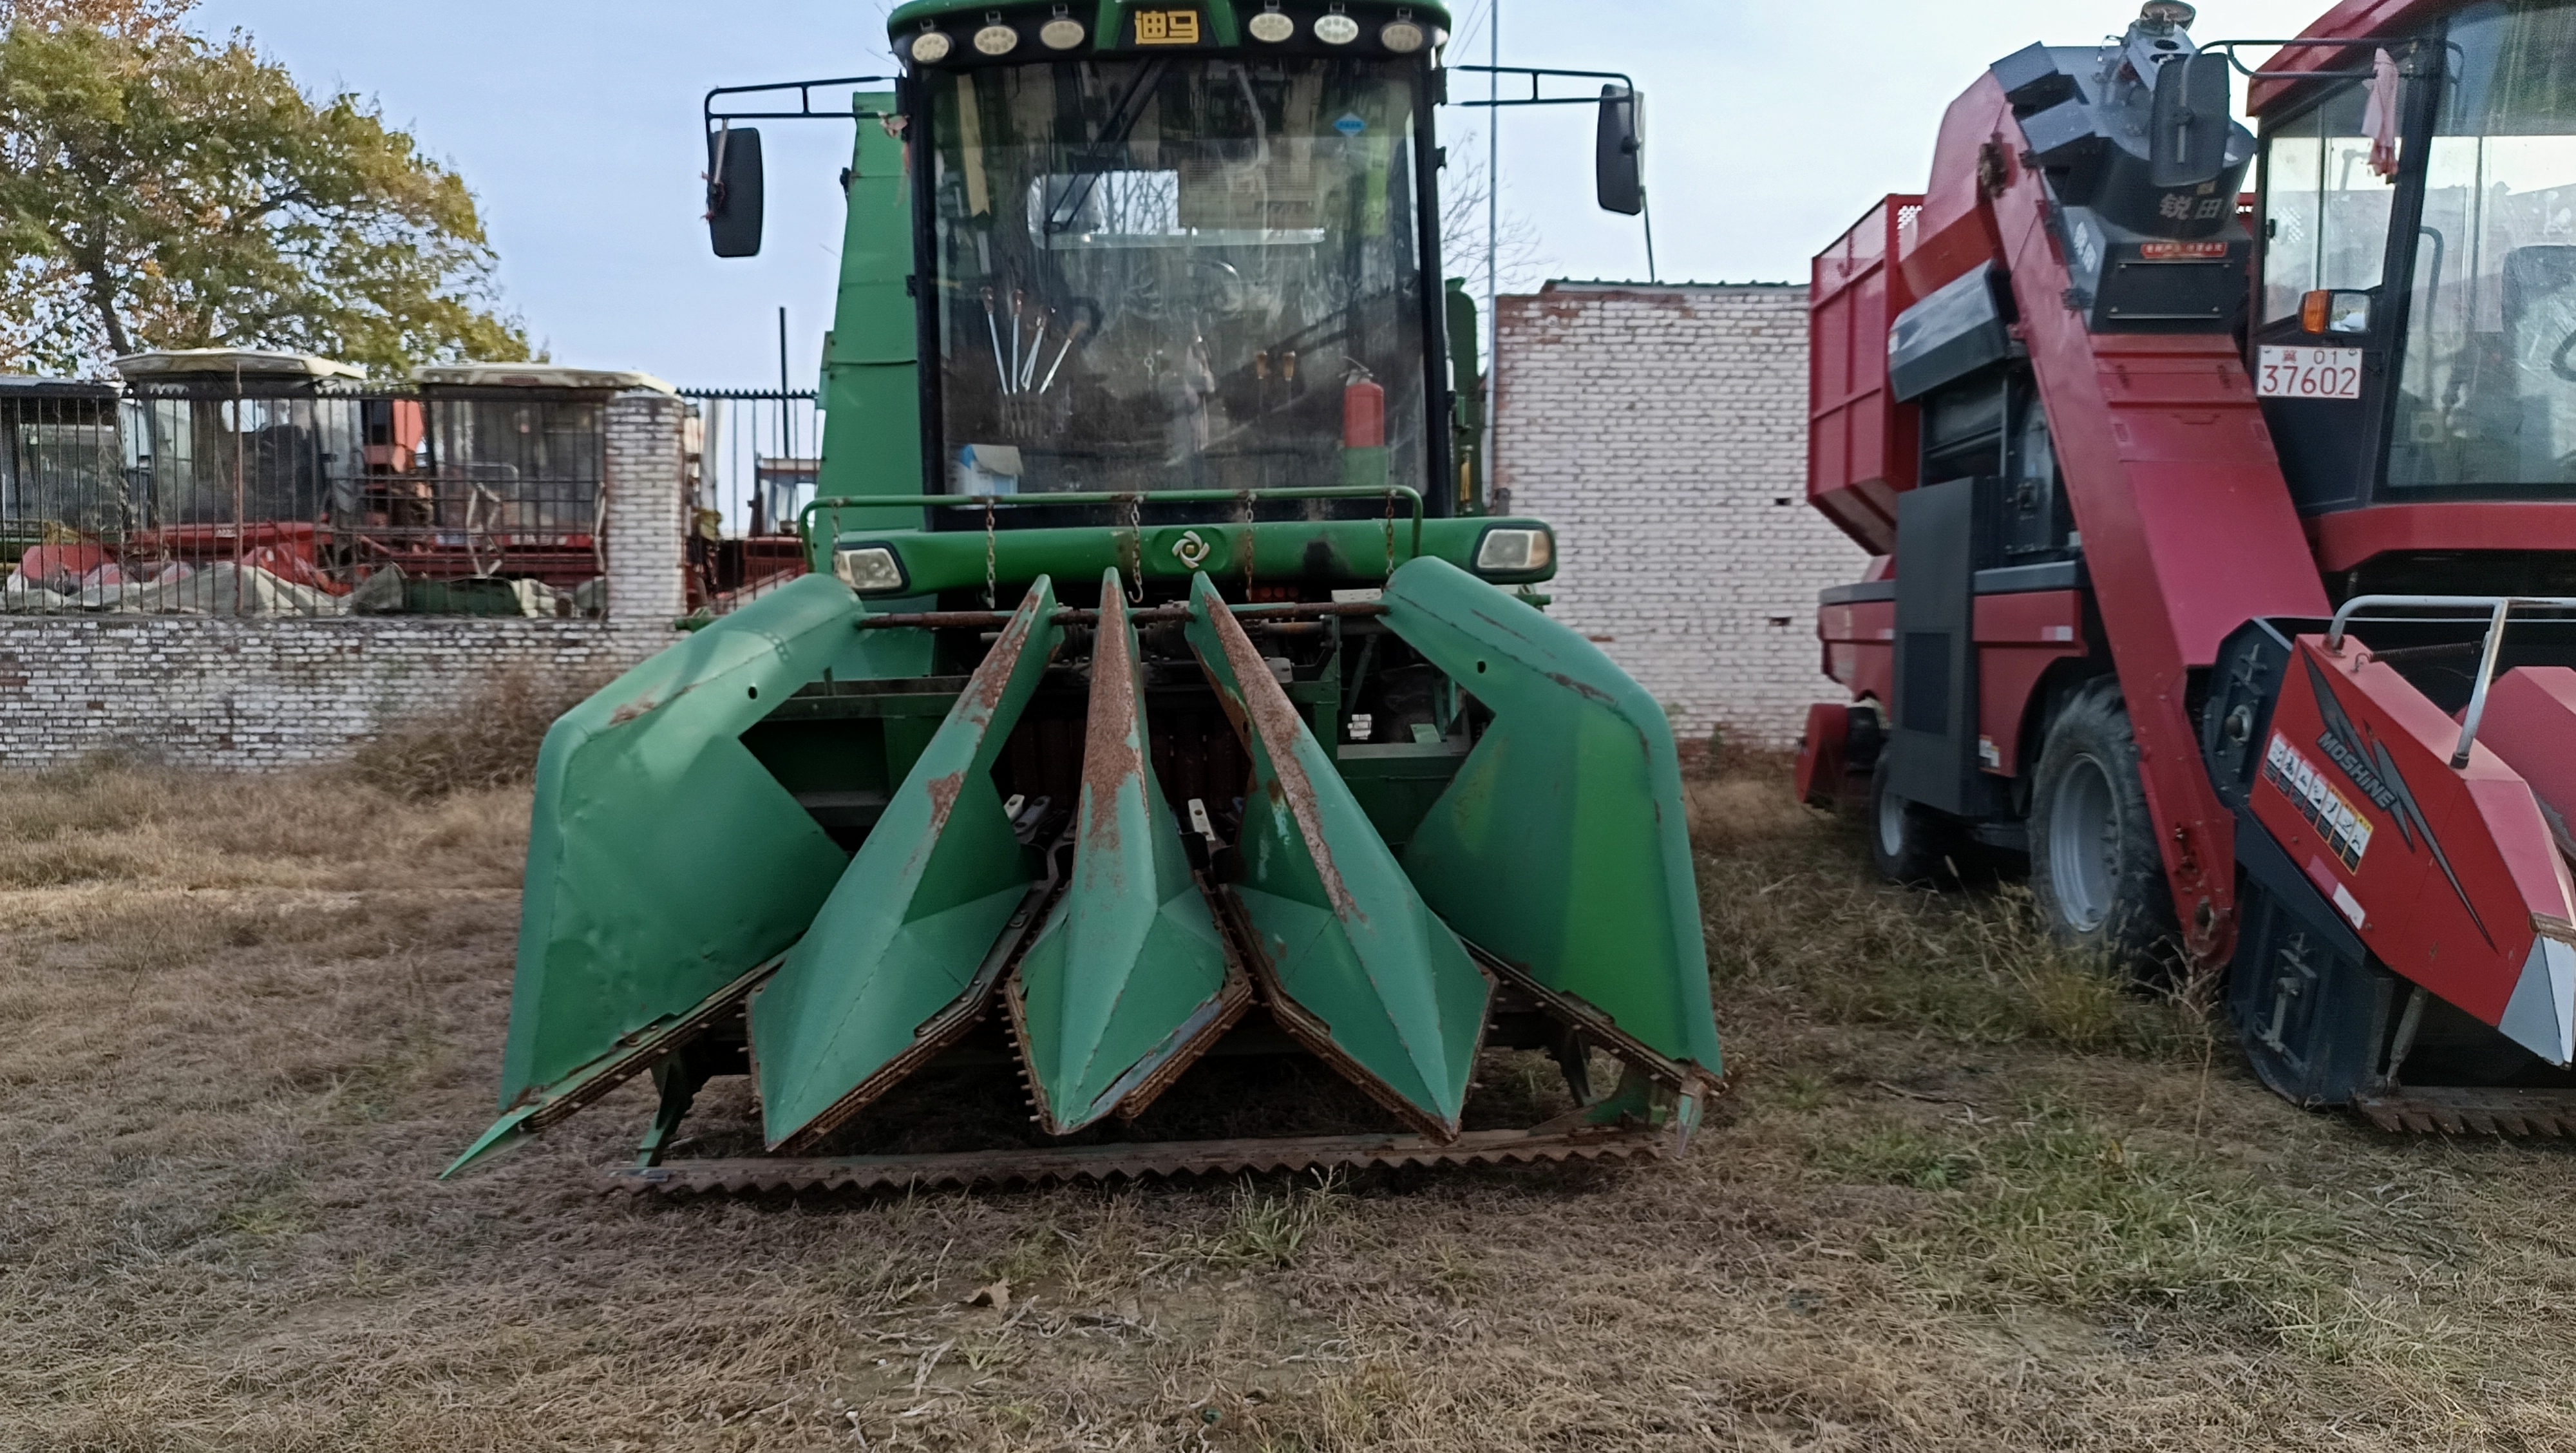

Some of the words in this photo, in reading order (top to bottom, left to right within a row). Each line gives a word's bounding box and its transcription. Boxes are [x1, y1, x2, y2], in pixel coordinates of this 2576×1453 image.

[1135, 10, 1198, 44] 迪马
[2313, 350, 2338, 365] 01
[2262, 365, 2356, 395] 37602
